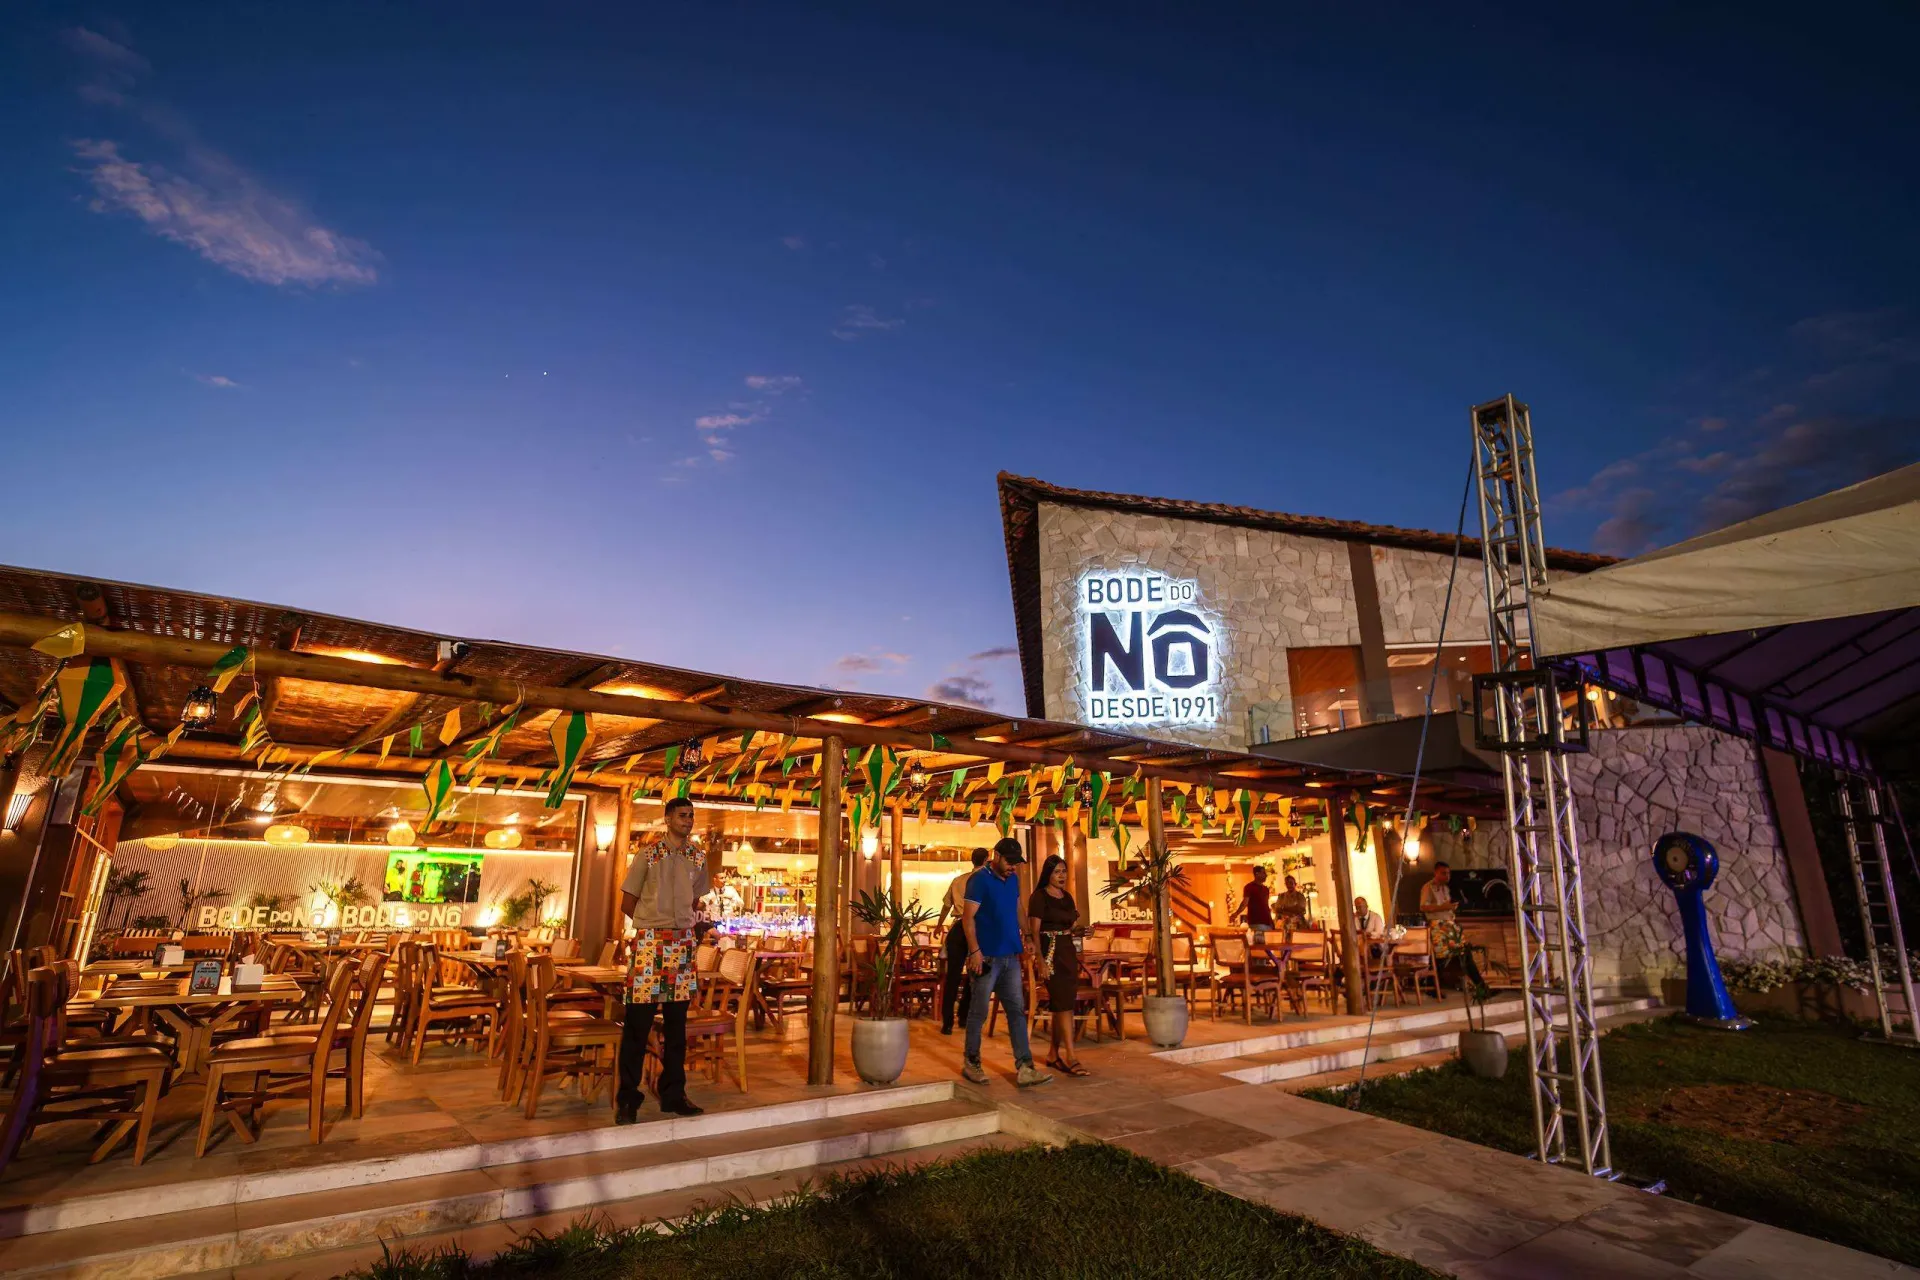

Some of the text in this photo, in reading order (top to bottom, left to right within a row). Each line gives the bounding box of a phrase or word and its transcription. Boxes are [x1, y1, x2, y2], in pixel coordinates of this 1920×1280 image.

[1088, 576, 1192, 604] BODE DO
[1089, 609, 1211, 692] NÔ
[1091, 696, 1216, 719] DESDE 1991
[198, 906, 270, 928] BODE
[270, 910, 292, 923] DO
[342, 905, 462, 928] BODE DO NÔ
